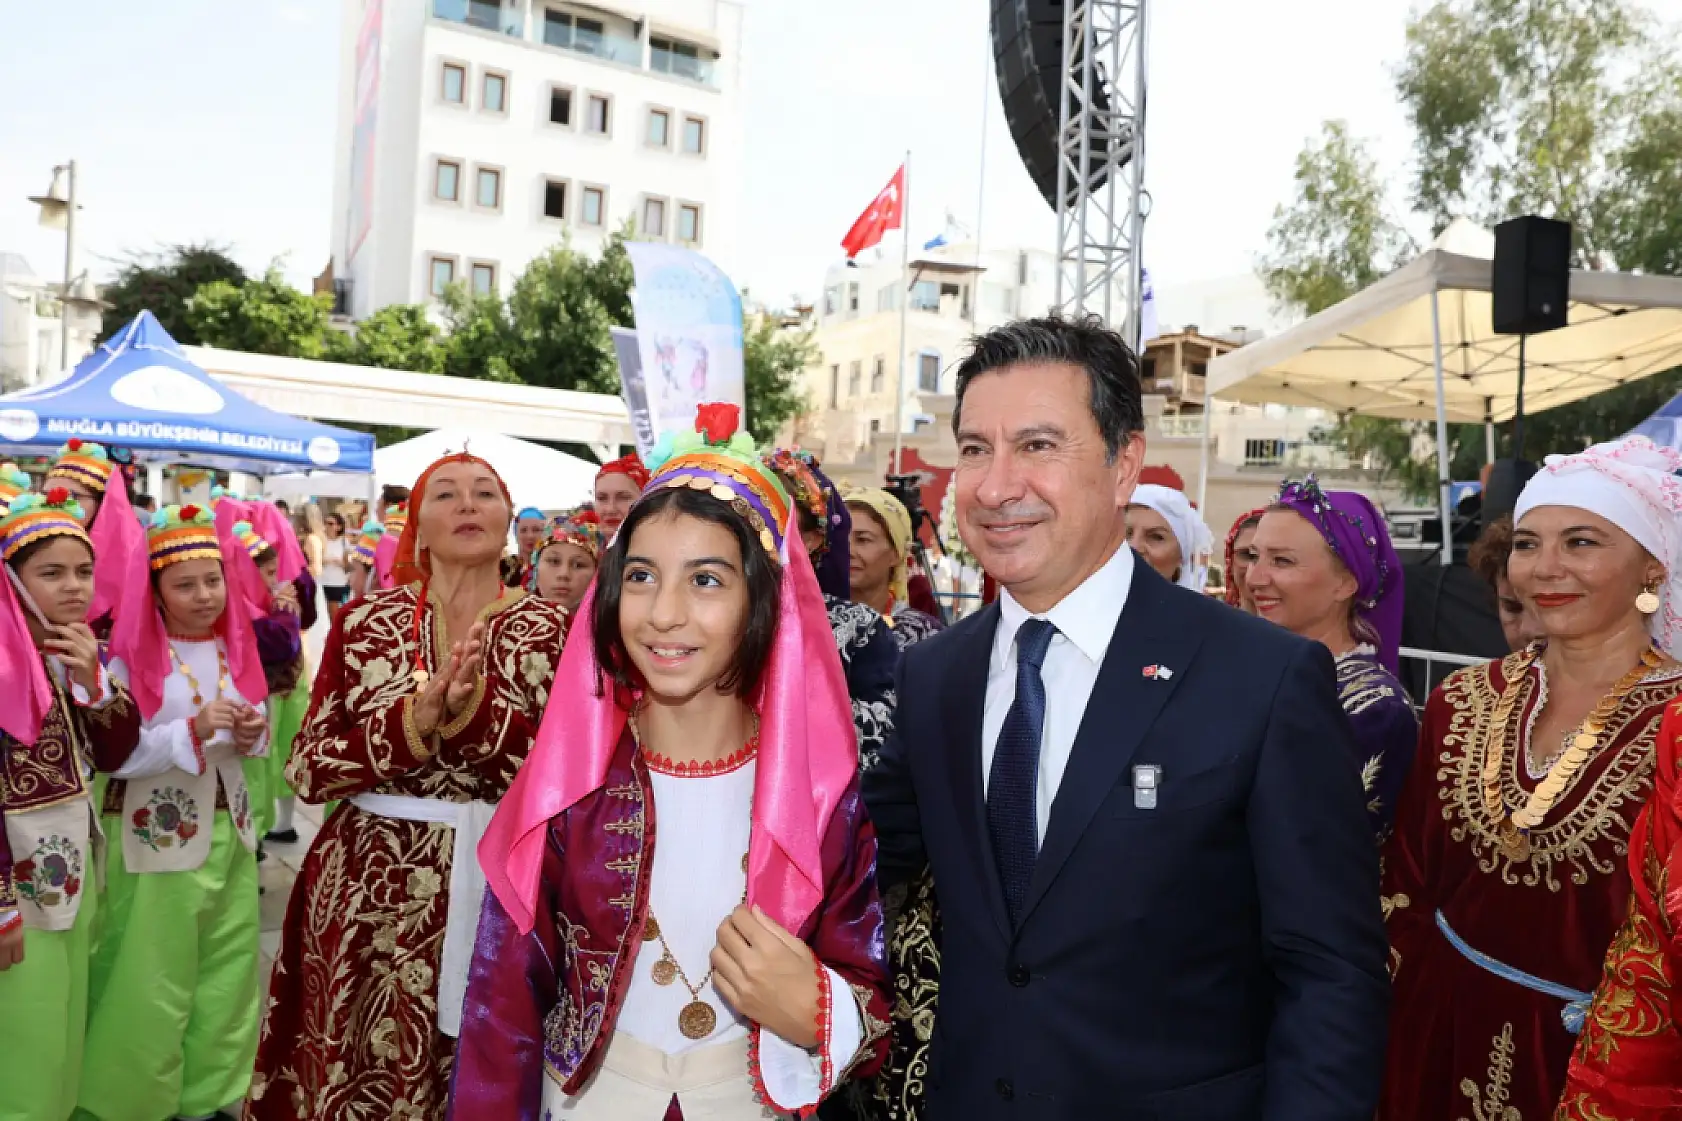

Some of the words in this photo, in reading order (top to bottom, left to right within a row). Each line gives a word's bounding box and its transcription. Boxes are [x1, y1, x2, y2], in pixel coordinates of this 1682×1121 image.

[48, 416, 113, 436] MUĞLA
[117, 420, 219, 444] BÜYÜKŞEHİR
[221, 431, 302, 454] BELEDİYESİ
